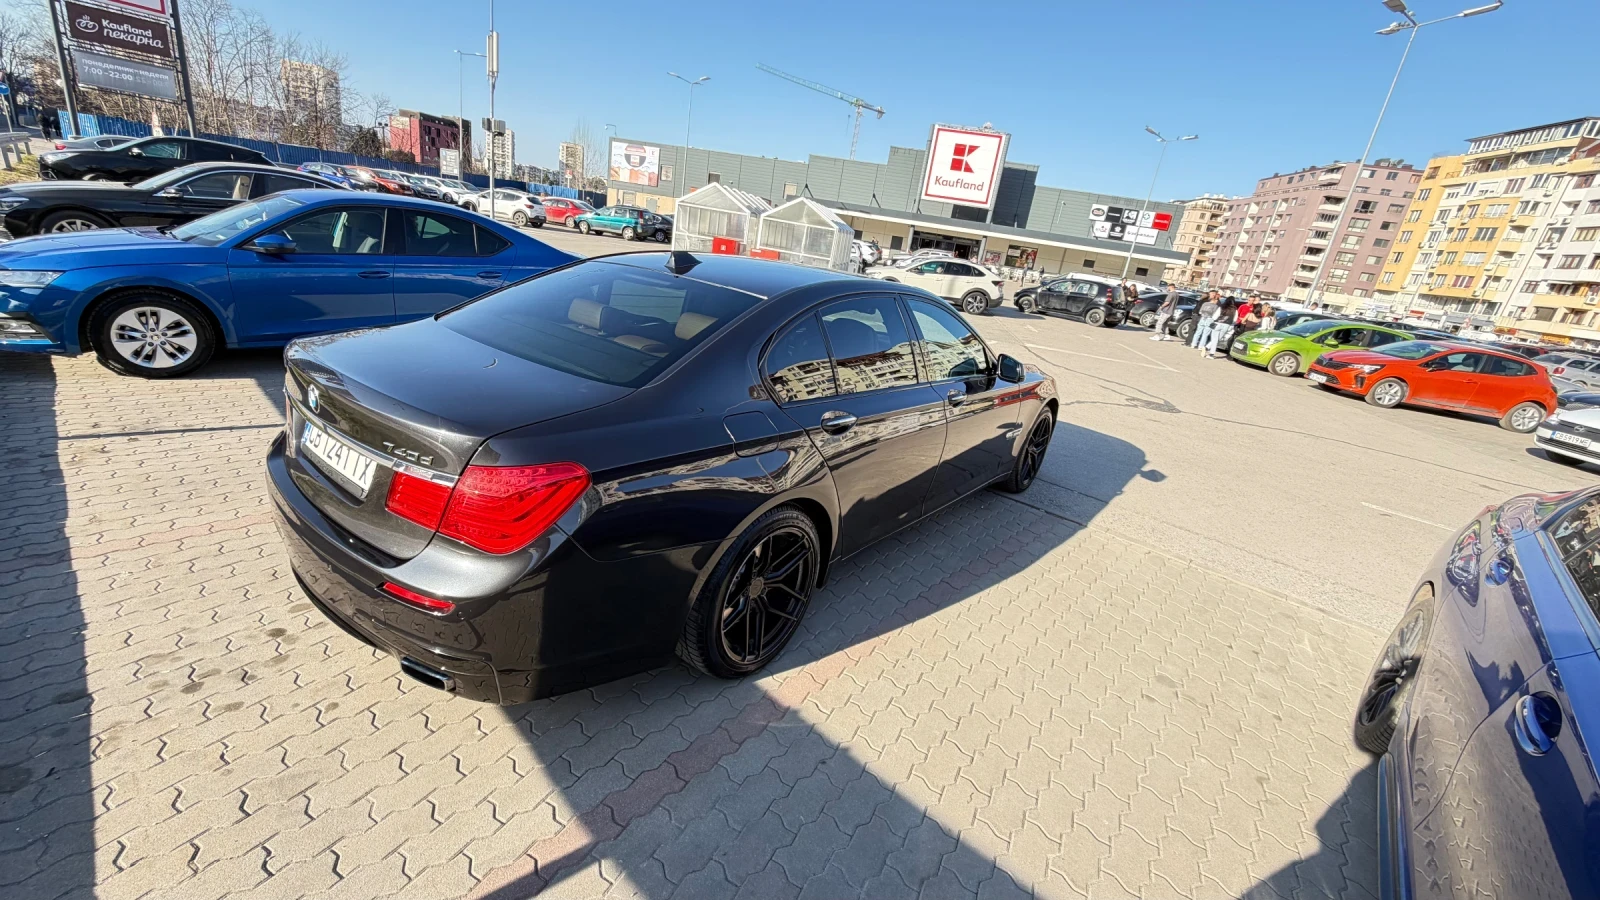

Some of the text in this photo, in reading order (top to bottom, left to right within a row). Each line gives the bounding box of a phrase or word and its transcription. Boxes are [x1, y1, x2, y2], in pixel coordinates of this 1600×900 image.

[101, 18, 152, 37] Kaufland
[103, 28, 164, 49] пекарна
[934, 175, 985, 192] Kaufland
